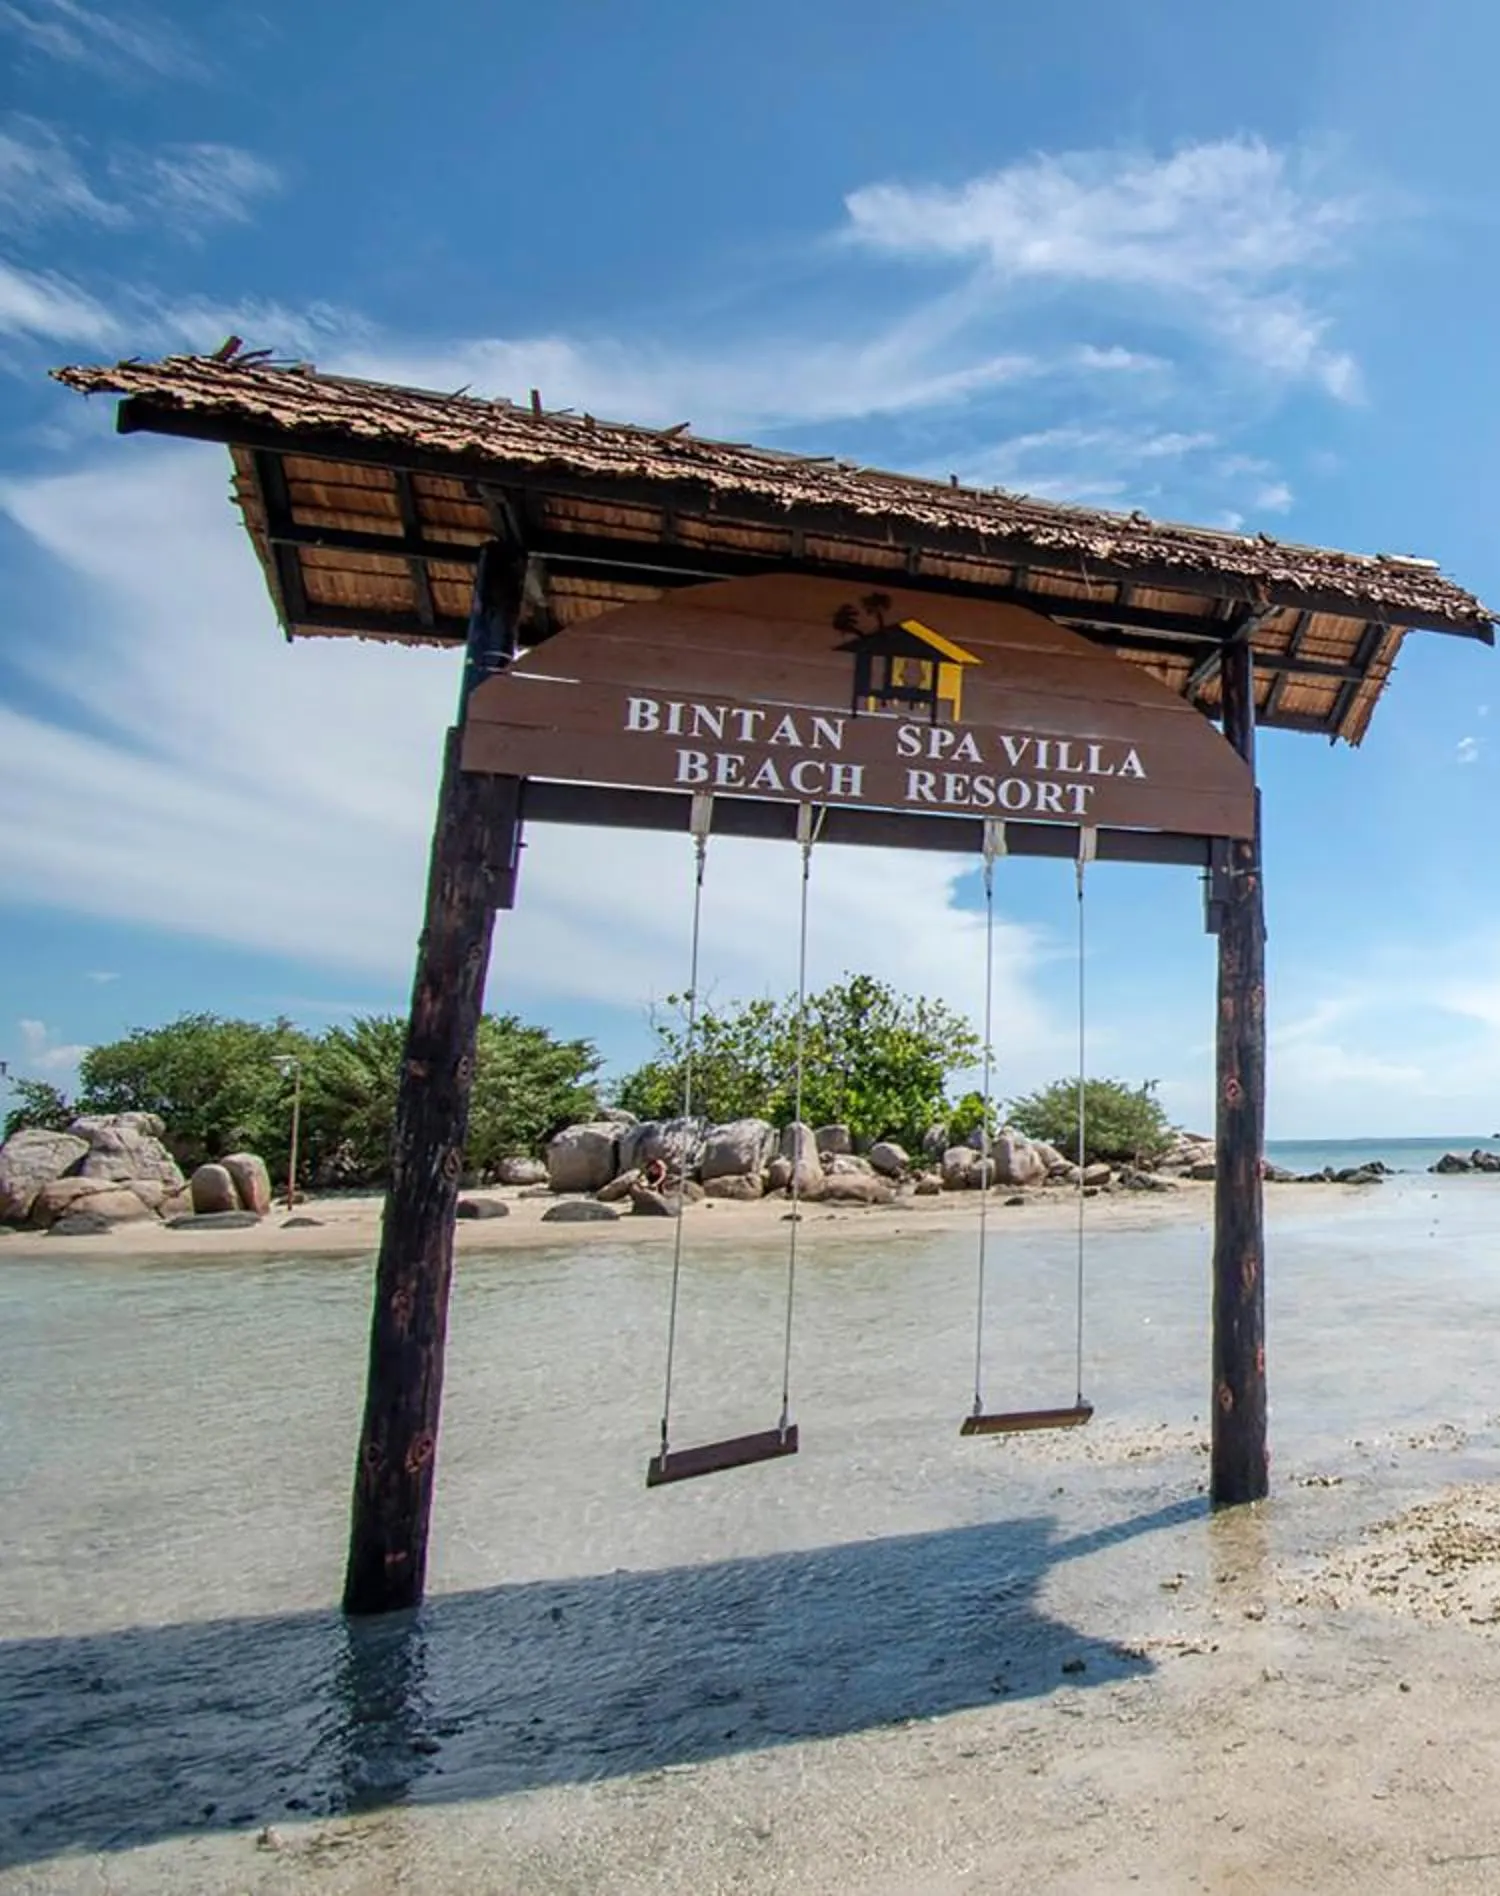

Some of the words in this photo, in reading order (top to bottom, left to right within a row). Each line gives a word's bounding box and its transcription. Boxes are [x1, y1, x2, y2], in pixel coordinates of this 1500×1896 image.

[624, 696, 845, 750] BINTAN
[897, 724, 984, 764] SPA
[1000, 734, 1147, 779] VILLA
[675, 748, 865, 797] BEACH
[905, 768, 1095, 816] RESORT
